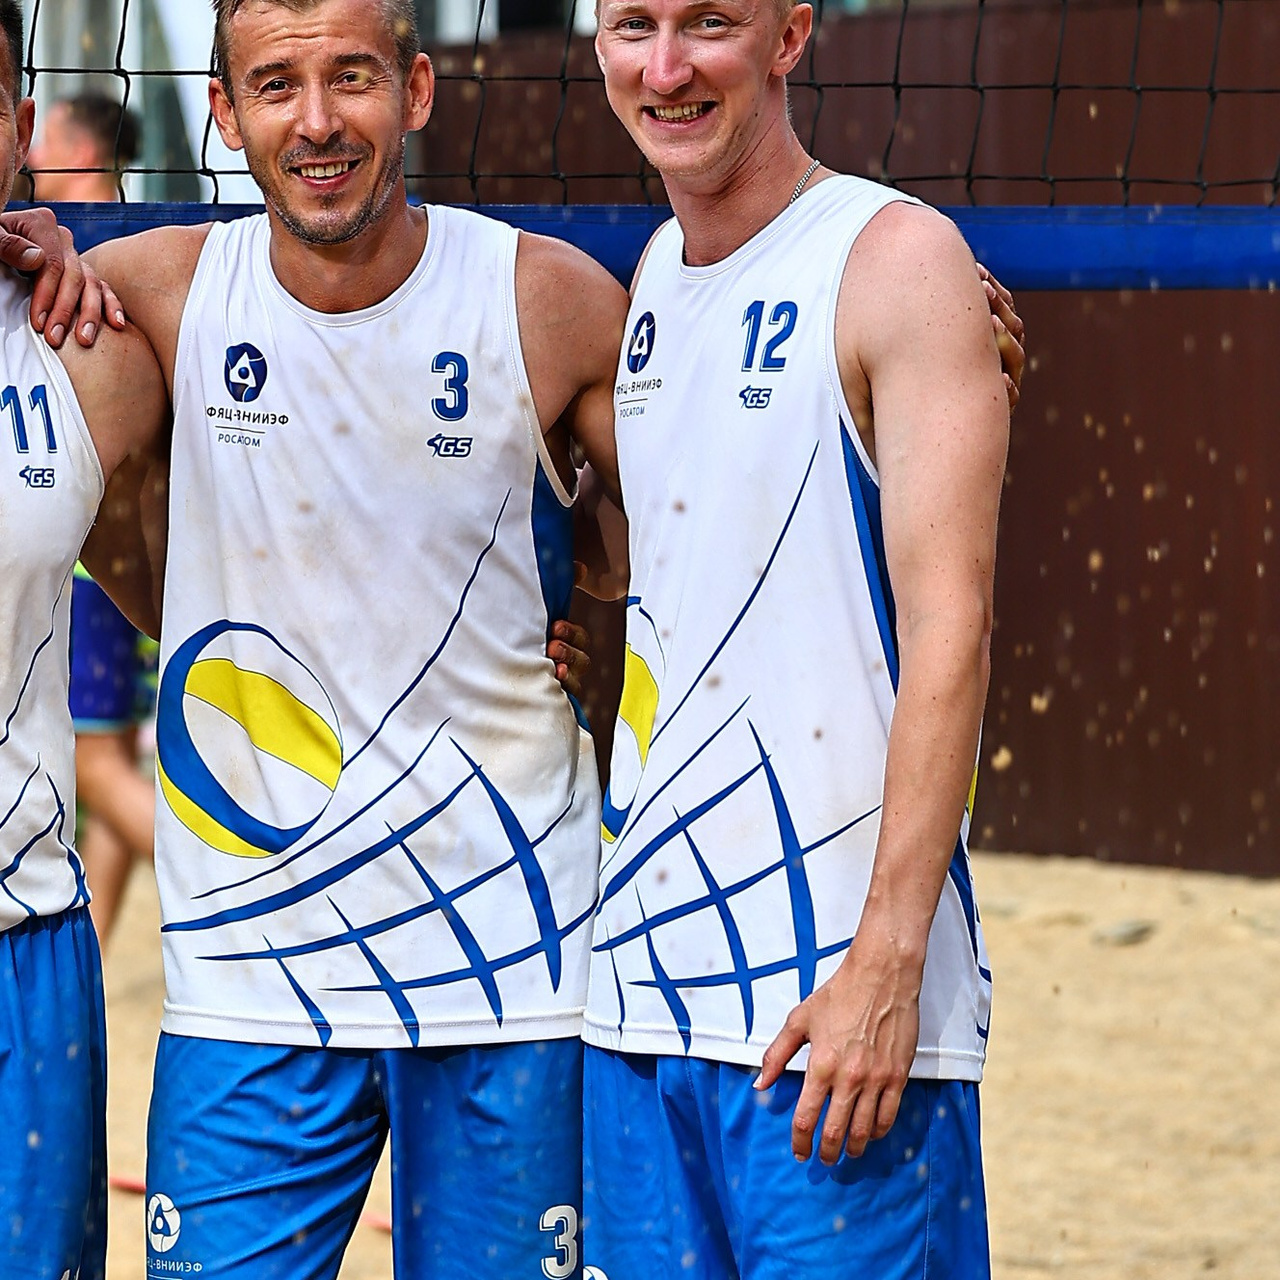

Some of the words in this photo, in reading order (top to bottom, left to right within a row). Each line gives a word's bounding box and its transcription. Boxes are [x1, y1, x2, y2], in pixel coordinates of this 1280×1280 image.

[741, 299, 798, 372] 12
[431, 351, 469, 421] 3
[539, 1204, 578, 1280] 3
